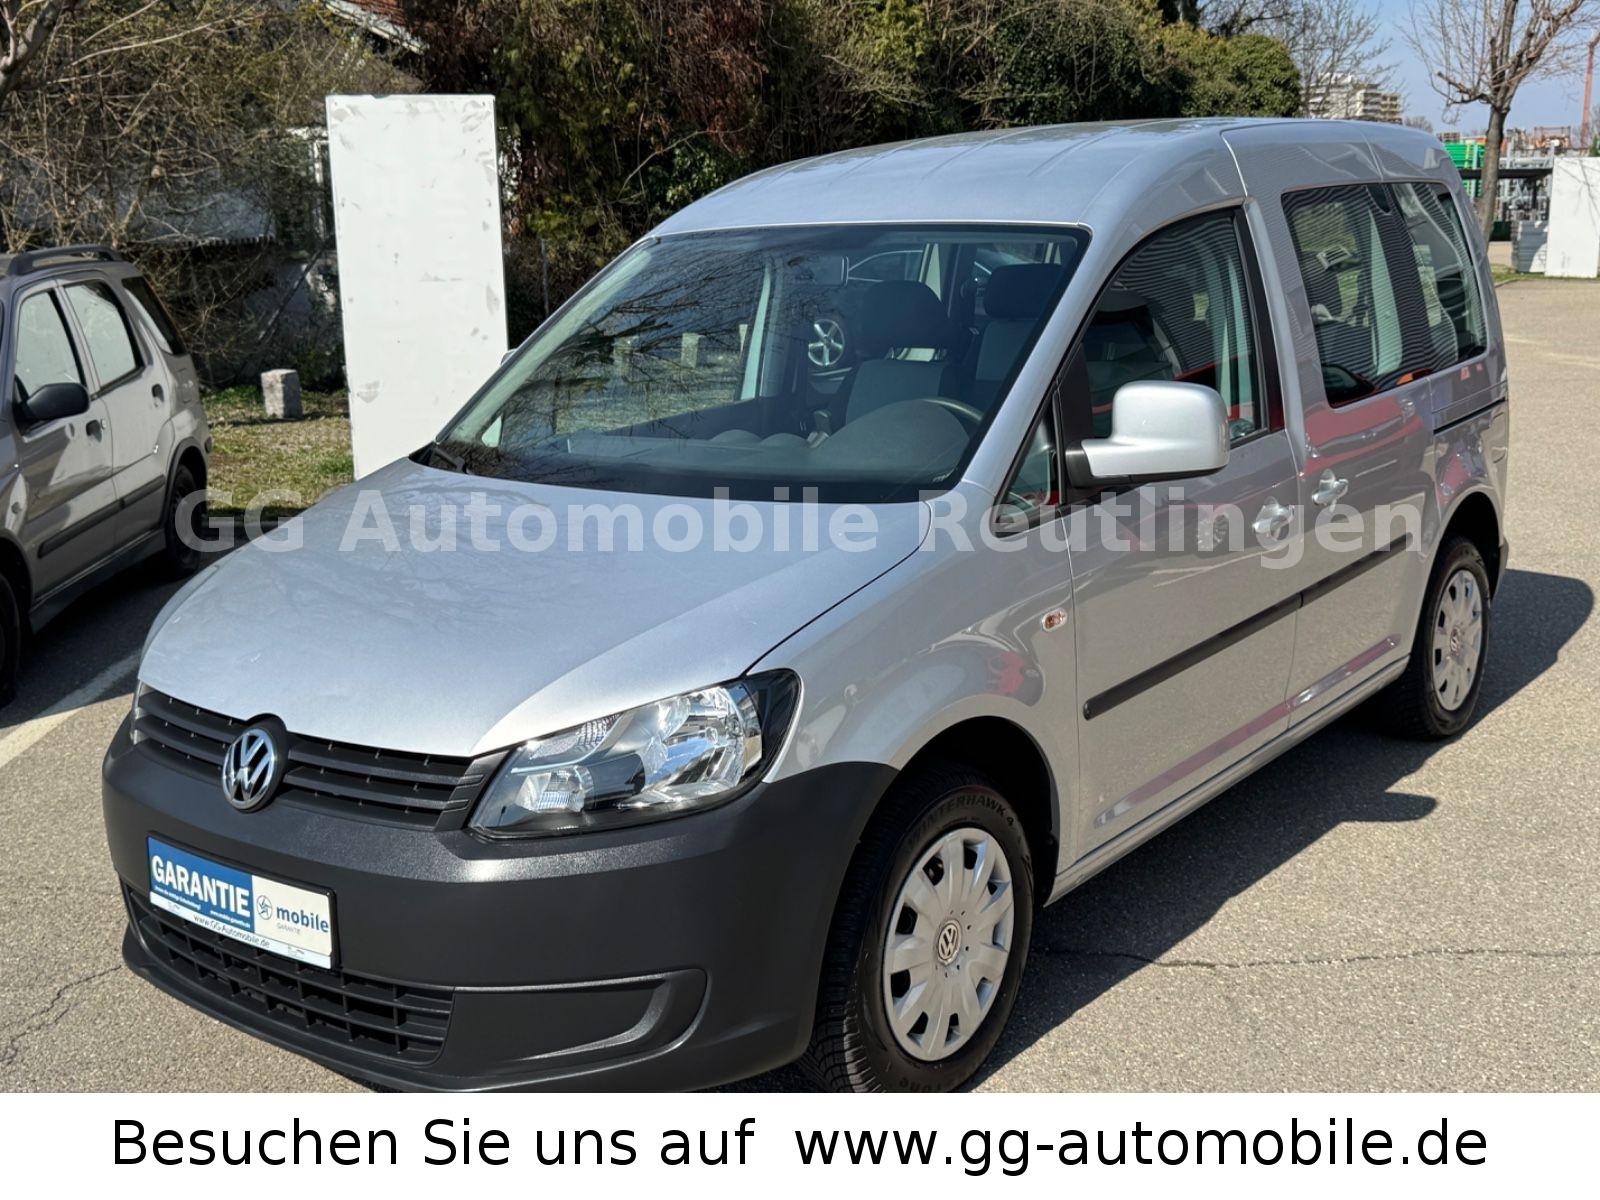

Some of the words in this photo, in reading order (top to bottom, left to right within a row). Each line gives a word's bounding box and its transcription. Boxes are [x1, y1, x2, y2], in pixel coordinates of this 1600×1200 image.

[222, 728, 275, 810] VW
[151, 855, 251, 917] GARANTIE
[276, 905, 330, 934] mobile
